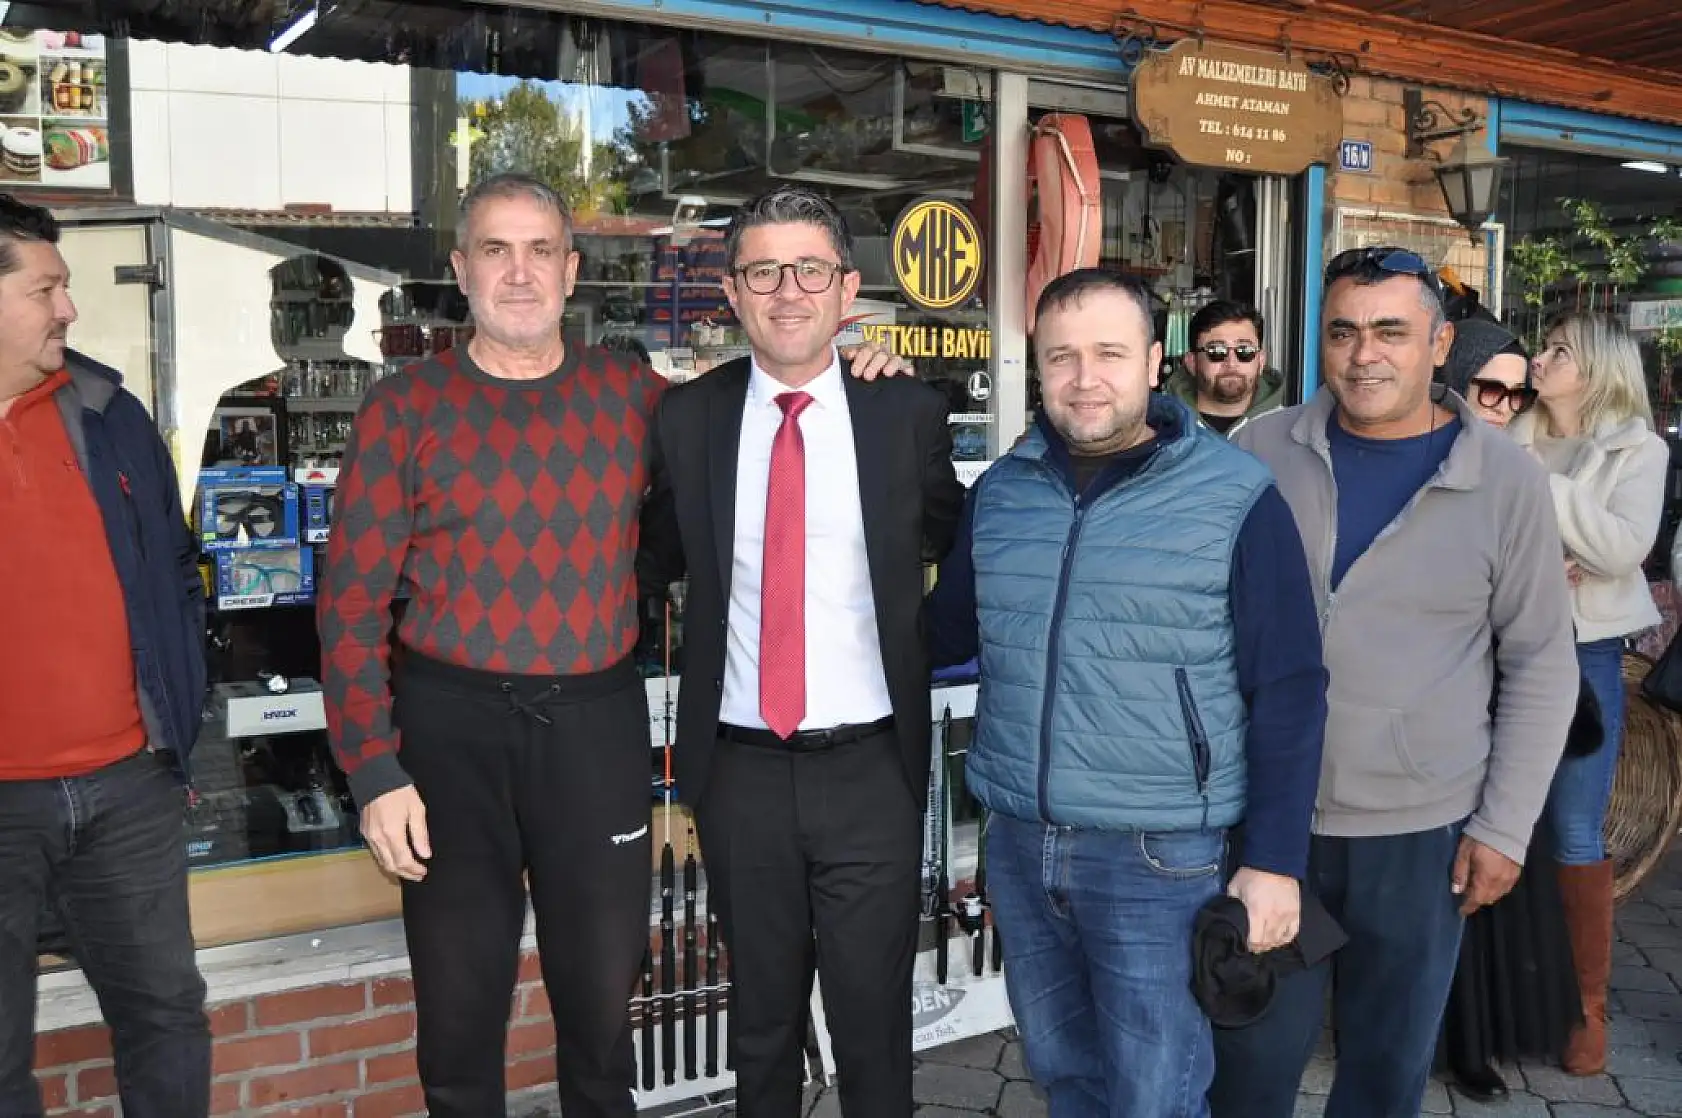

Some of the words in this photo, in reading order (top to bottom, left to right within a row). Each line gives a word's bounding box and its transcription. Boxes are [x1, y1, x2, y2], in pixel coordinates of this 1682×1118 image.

[1178, 56, 1196, 76] AV
[1195, 92, 1240, 110] AHMET
[1240, 98, 1291, 115] ATAMAN
[900, 207, 973, 301] MKE
